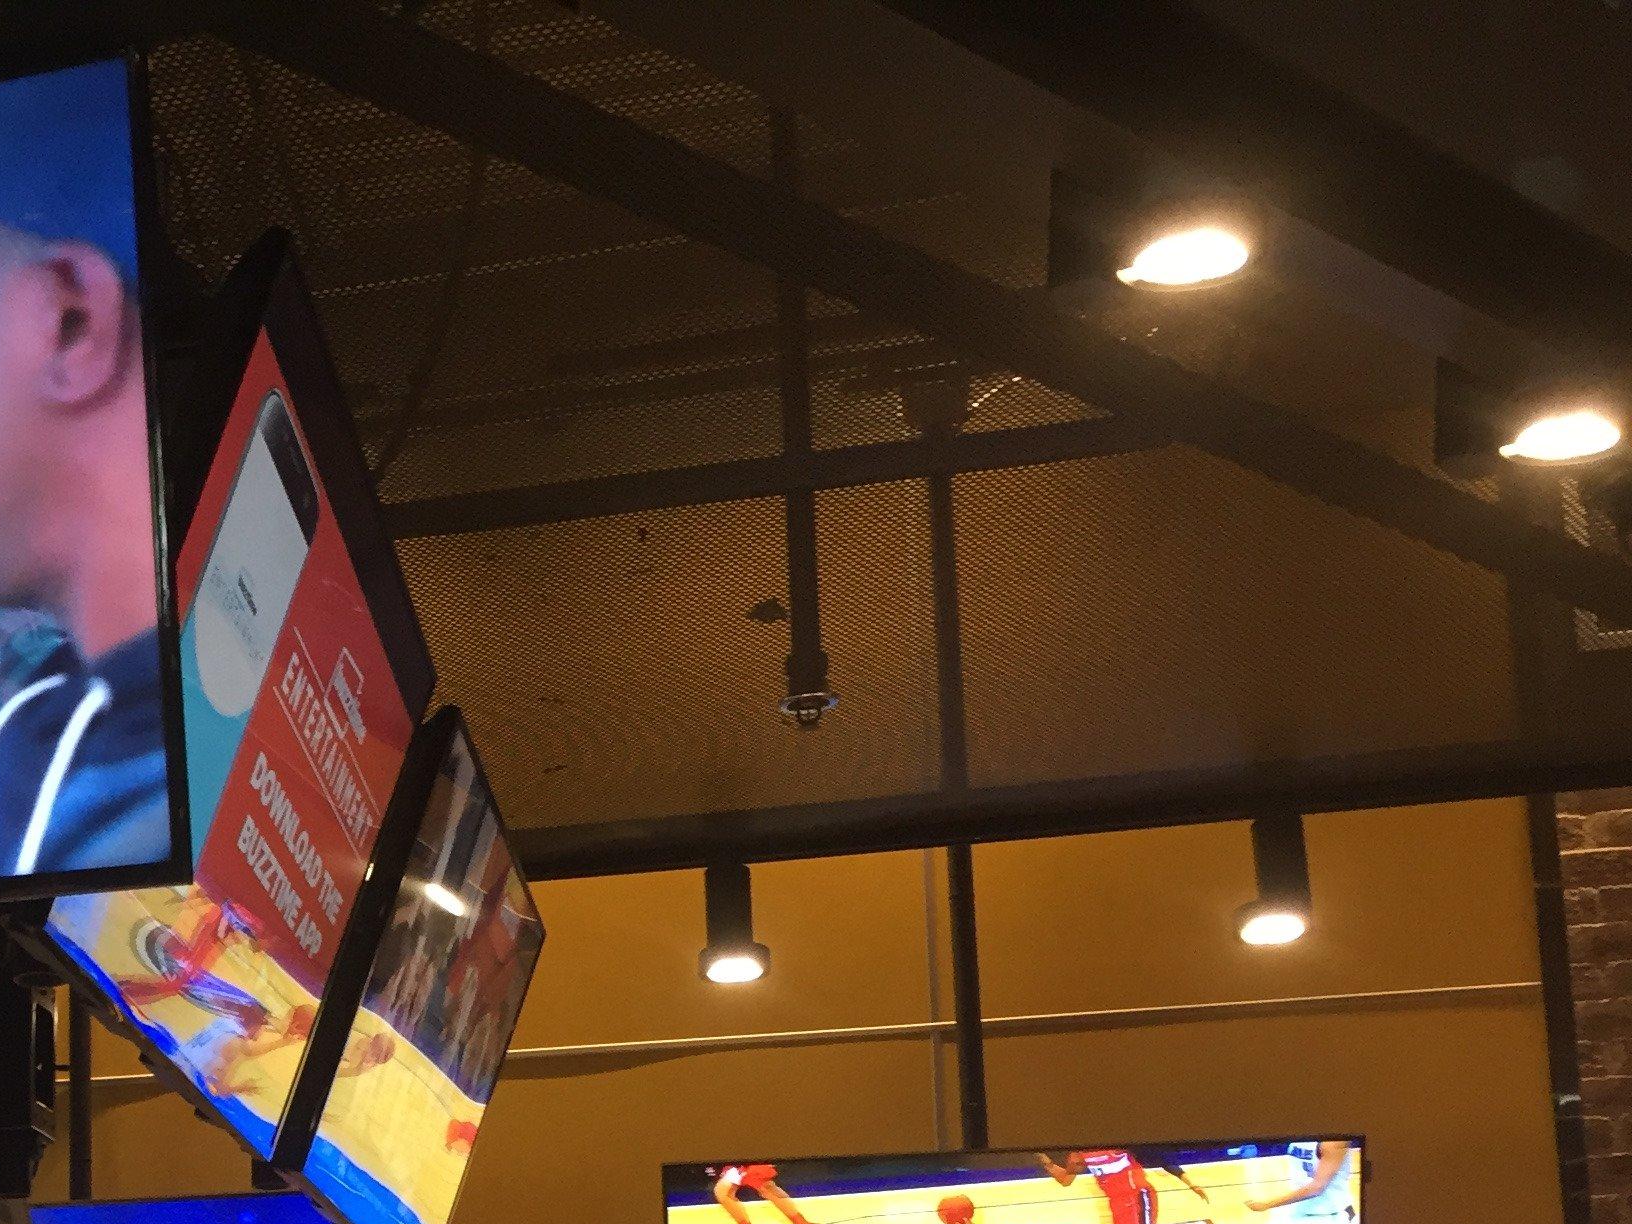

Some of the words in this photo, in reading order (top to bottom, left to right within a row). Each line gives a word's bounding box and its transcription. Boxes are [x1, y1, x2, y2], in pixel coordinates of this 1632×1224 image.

[237, 815, 302, 930] BUZZTIME
[294, 913, 323, 958] APP
[249, 751, 322, 888] DOWNLOAD
[318, 869, 344, 925] THE
